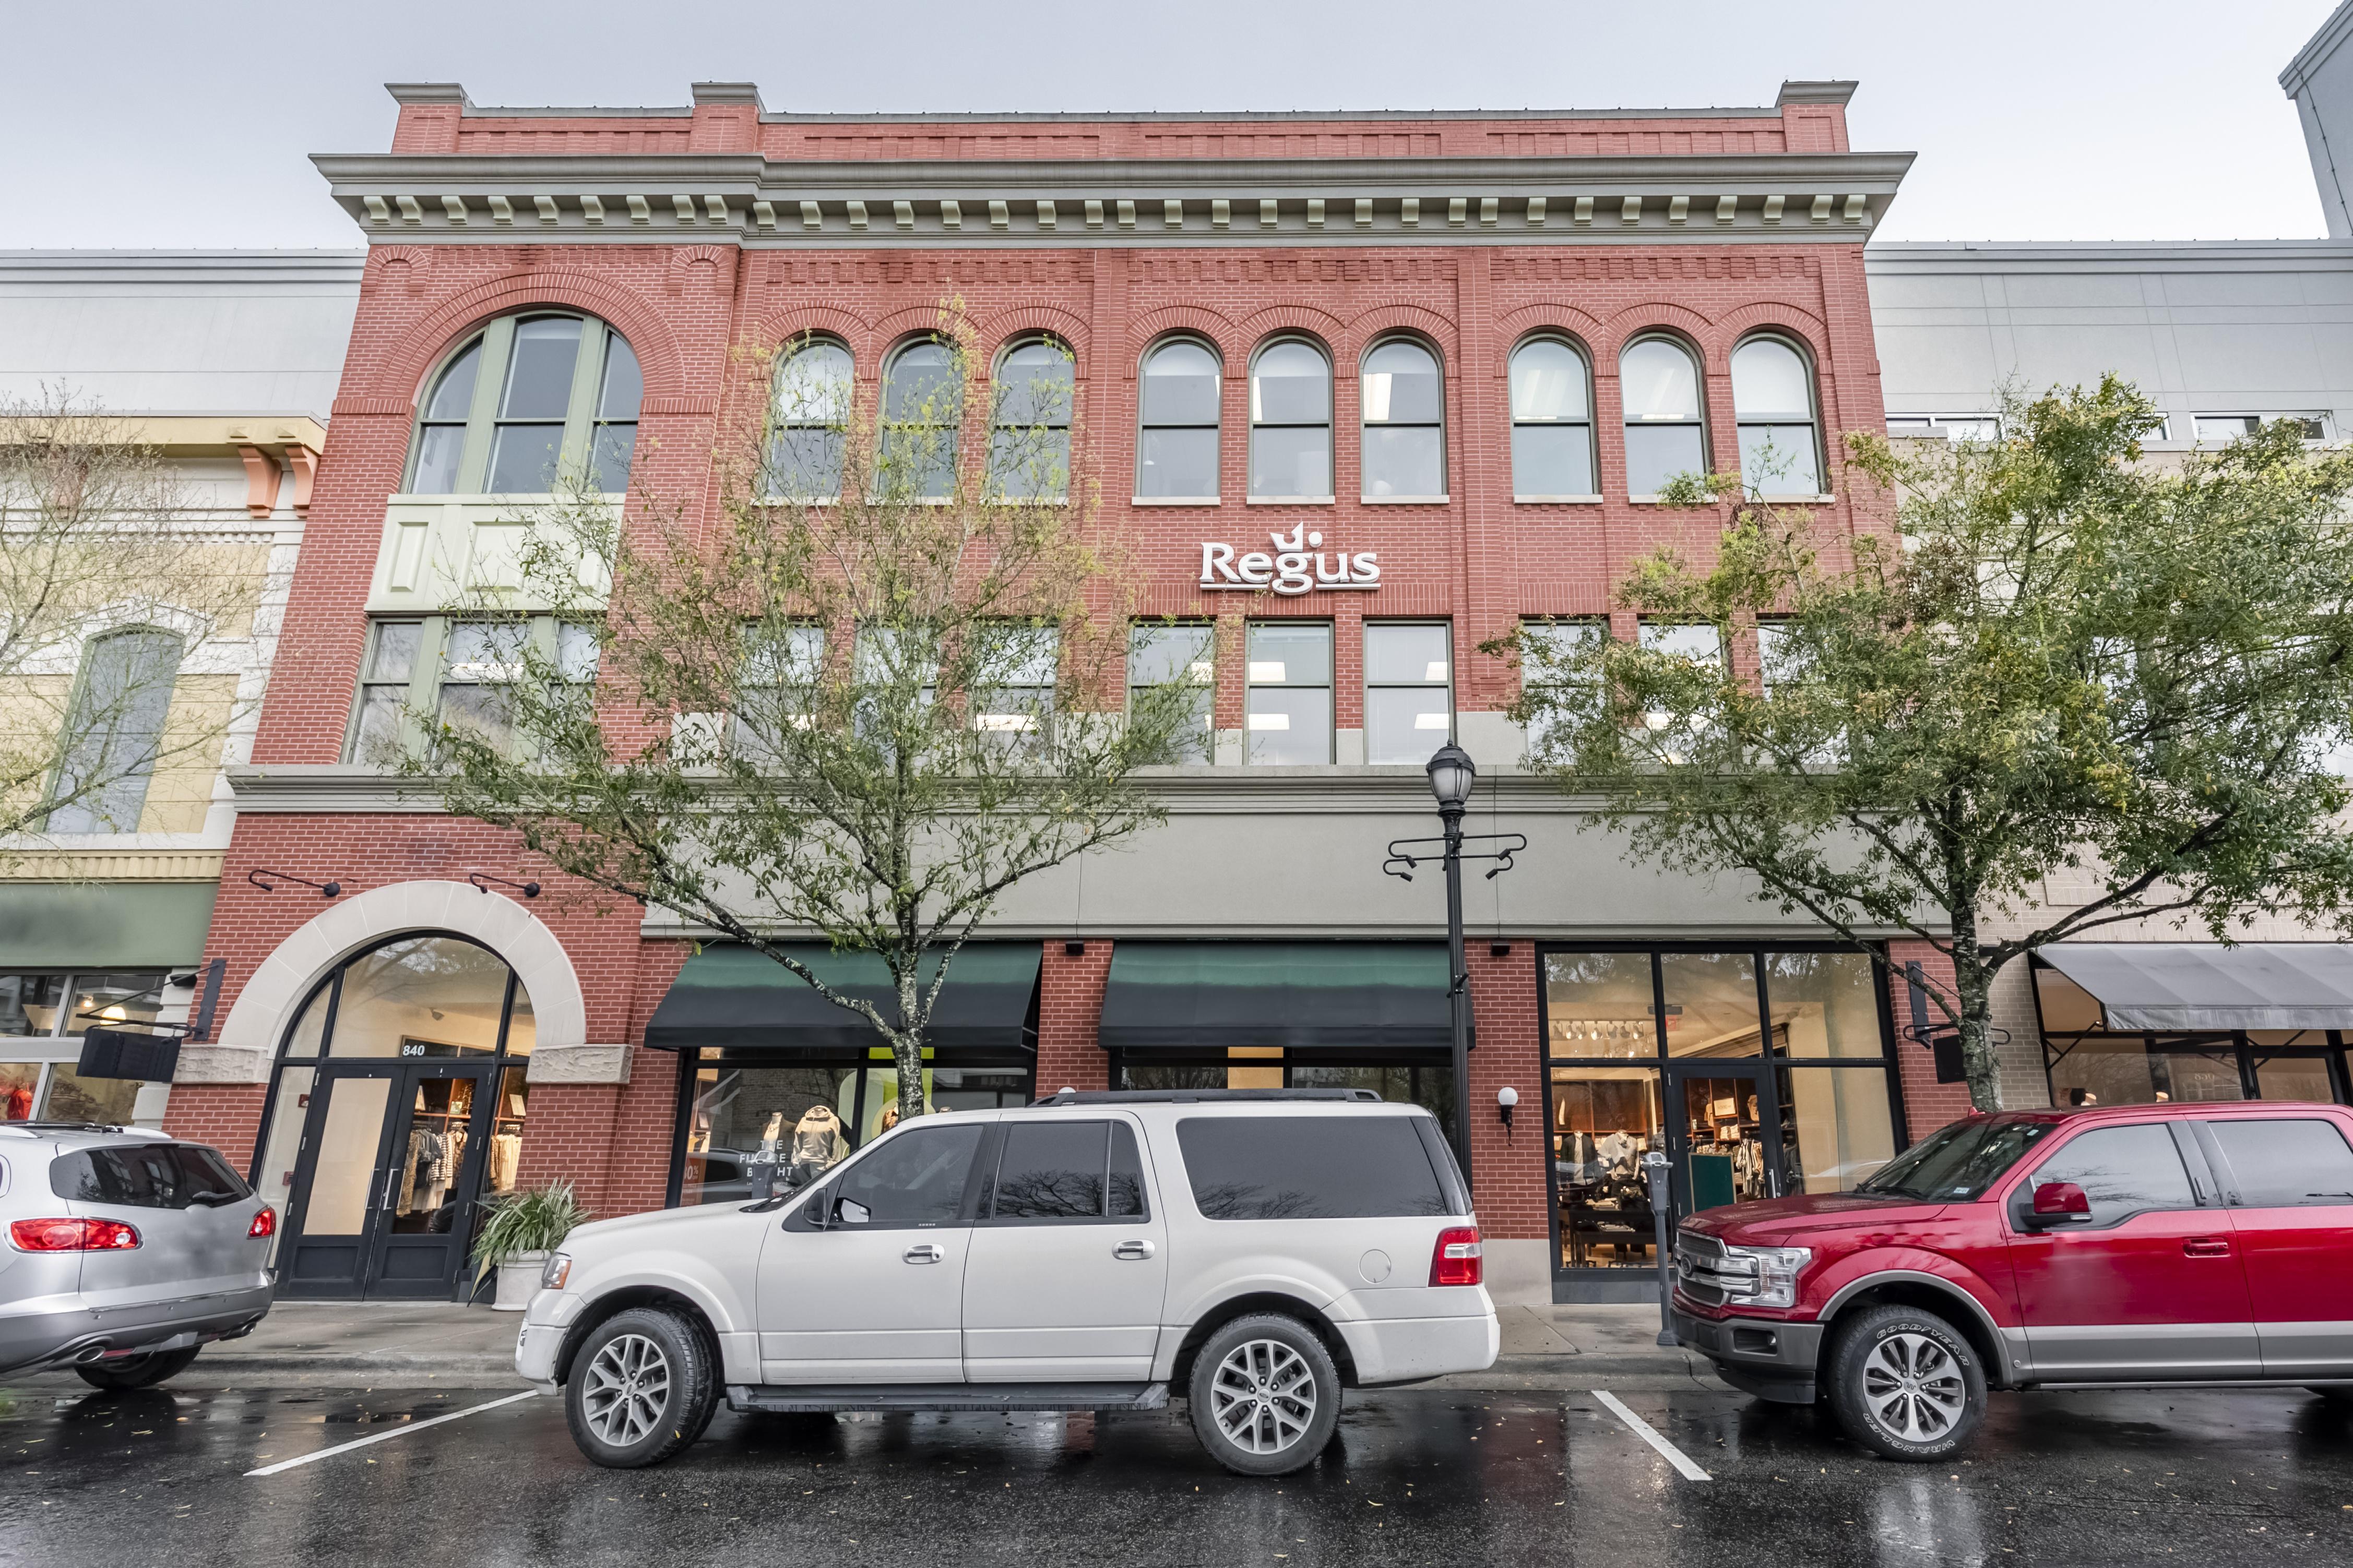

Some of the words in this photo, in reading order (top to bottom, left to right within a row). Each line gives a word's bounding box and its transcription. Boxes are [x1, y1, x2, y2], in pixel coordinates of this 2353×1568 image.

[1199, 541, 1381, 595] Regus
[402, 1045, 425, 1056] 840
[1877, 1323, 1969, 1366] GOODYEAR
[1863, 1413, 1956, 1454] WRANGLER
